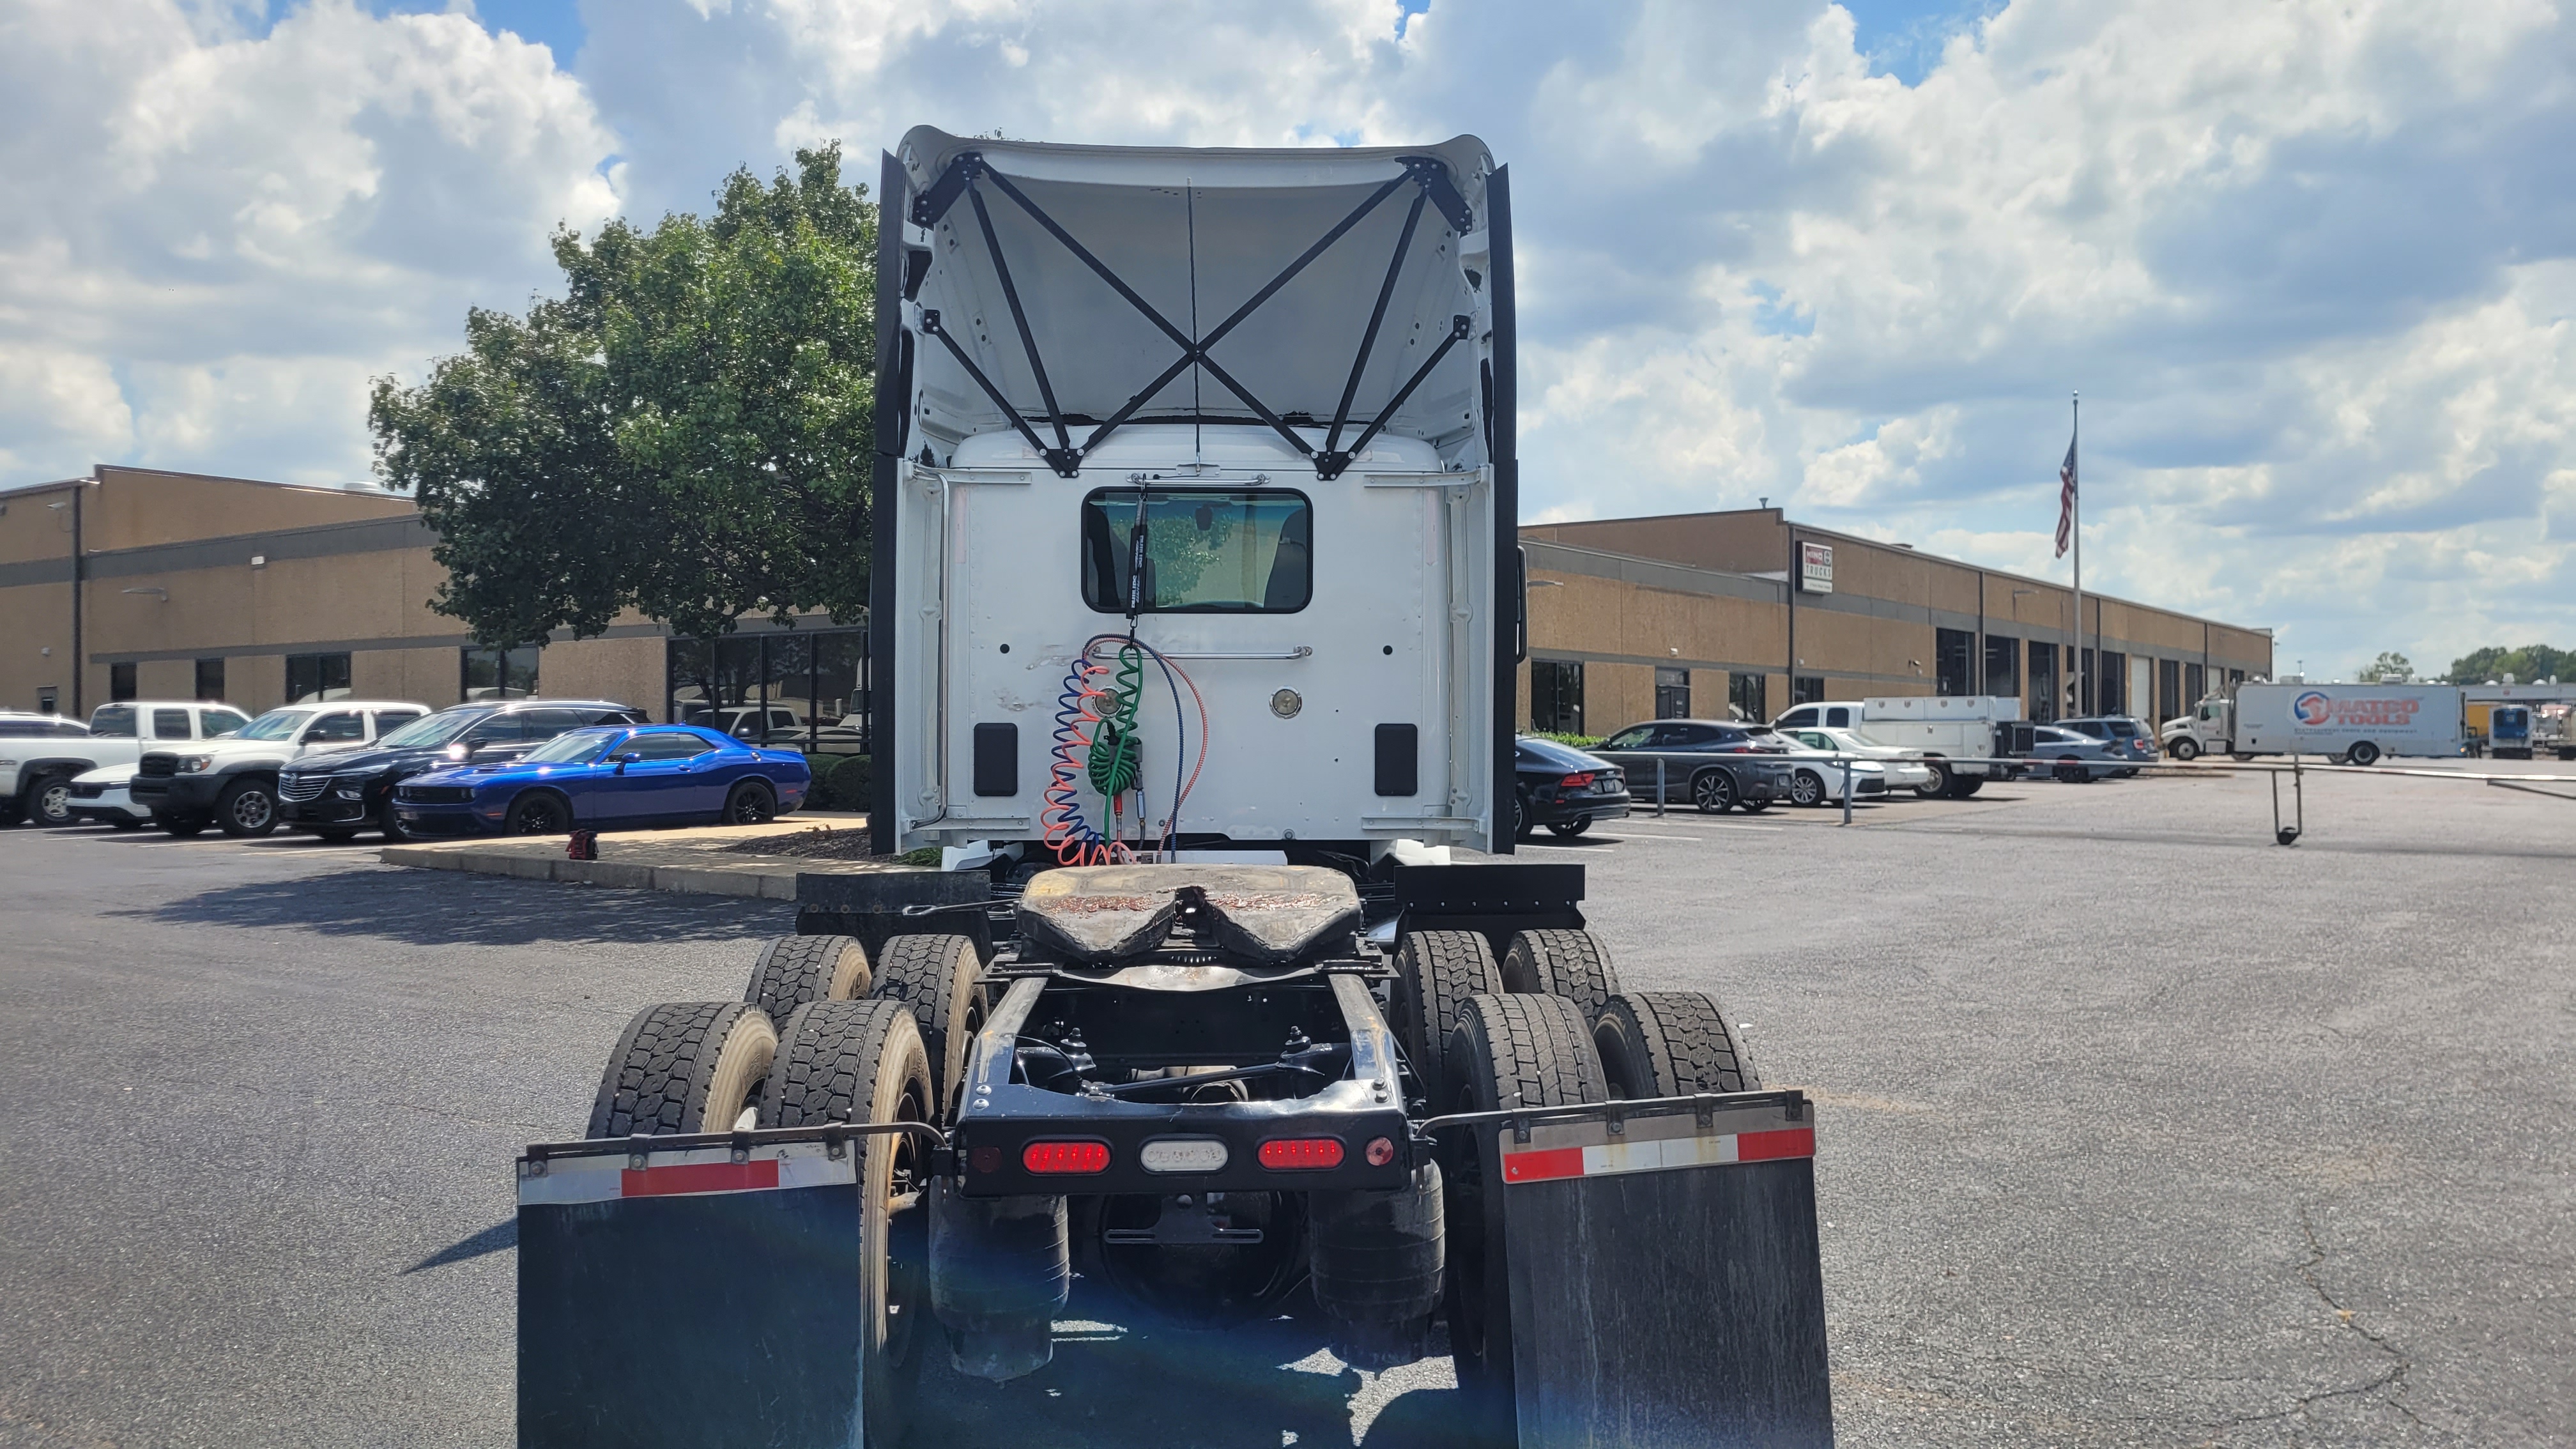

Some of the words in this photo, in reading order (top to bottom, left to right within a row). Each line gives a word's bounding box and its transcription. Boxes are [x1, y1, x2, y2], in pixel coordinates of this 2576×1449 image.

[1806, 565, 1830, 577] TRUCKS
[2327, 698, 2419, 714] MATCO
[2336, 714, 2411, 726] TOOLS
